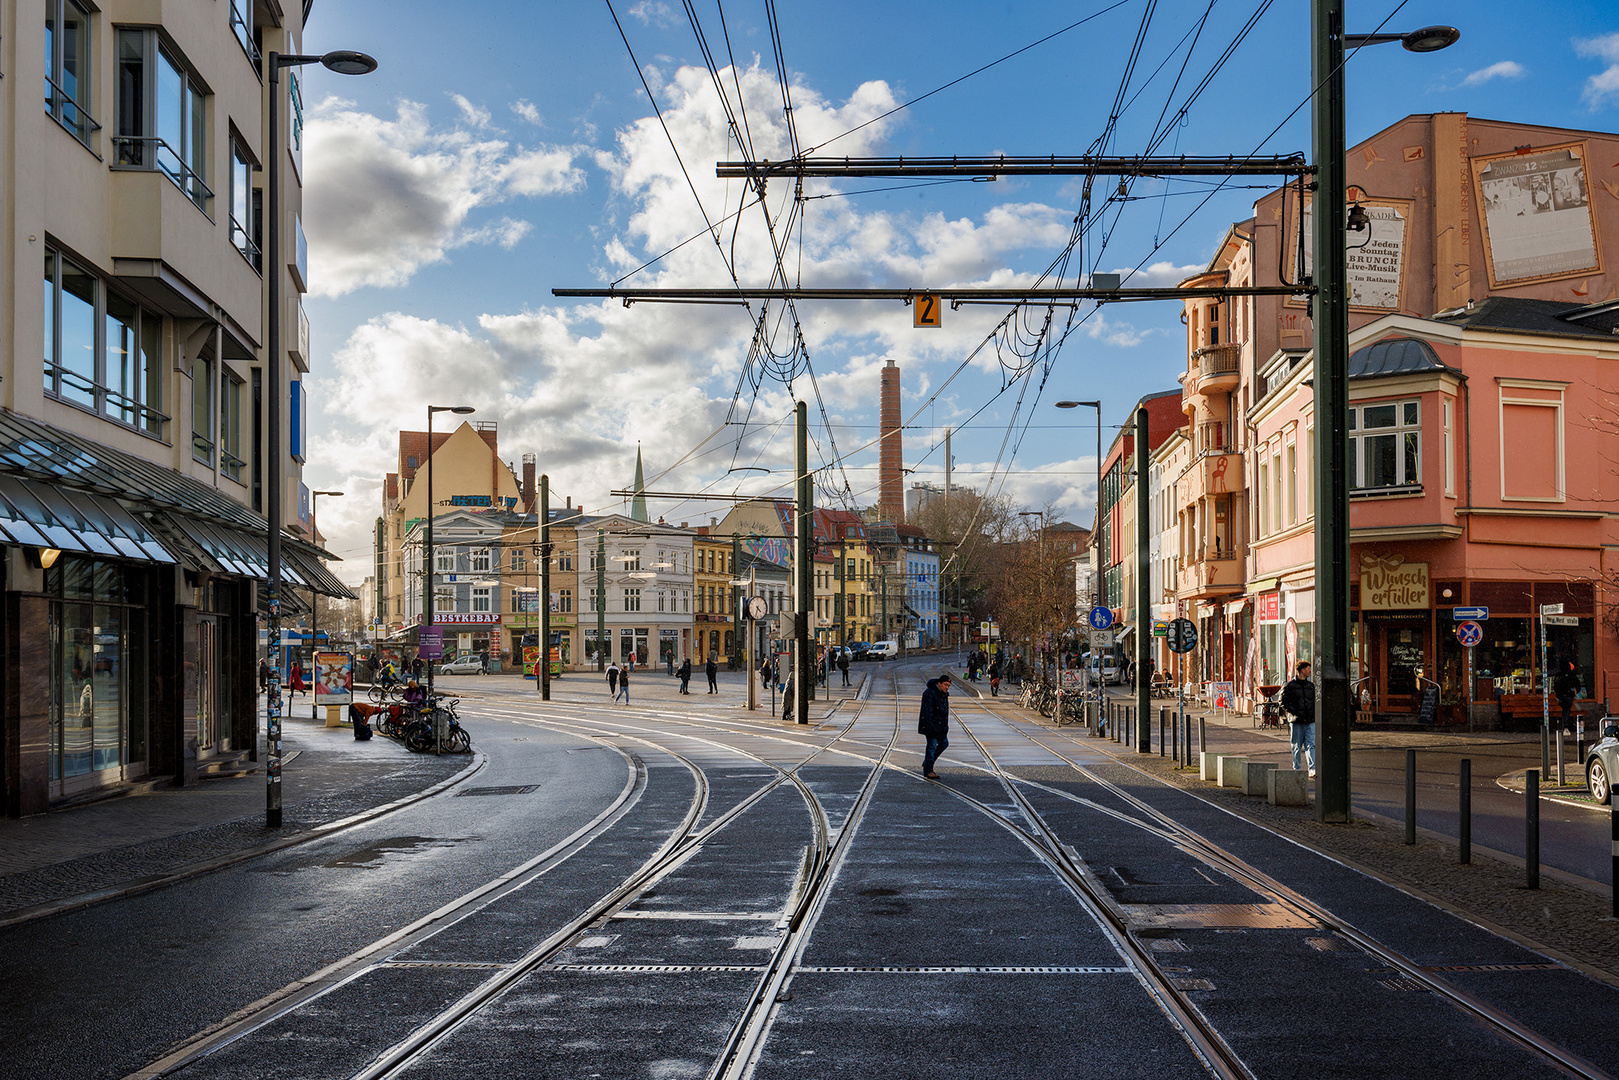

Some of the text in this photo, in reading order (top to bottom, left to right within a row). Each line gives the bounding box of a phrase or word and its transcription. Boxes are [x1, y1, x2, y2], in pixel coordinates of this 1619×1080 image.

[1460, 130, 1468, 143] MIT
[1460, 146, 1468, 164] DEM
[1460, 168, 1469, 212] SCHOENEN
[1461, 219, 1470, 246] LEBEN
[1371, 240, 1399, 249] Jeden
[1360, 247, 1399, 258] Sonntag
[1349, 255, 1398, 265] BRUNCH
[1346, 263, 1397, 273] Live-Musik
[1366, 276, 1397, 284] Rathaus
[920, 295, 934, 323] 2
[1358, 566, 1426, 590] Wunsch
[1371, 584, 1426, 608] erfüller
[434, 614, 499, 622] BESTKEBAP
